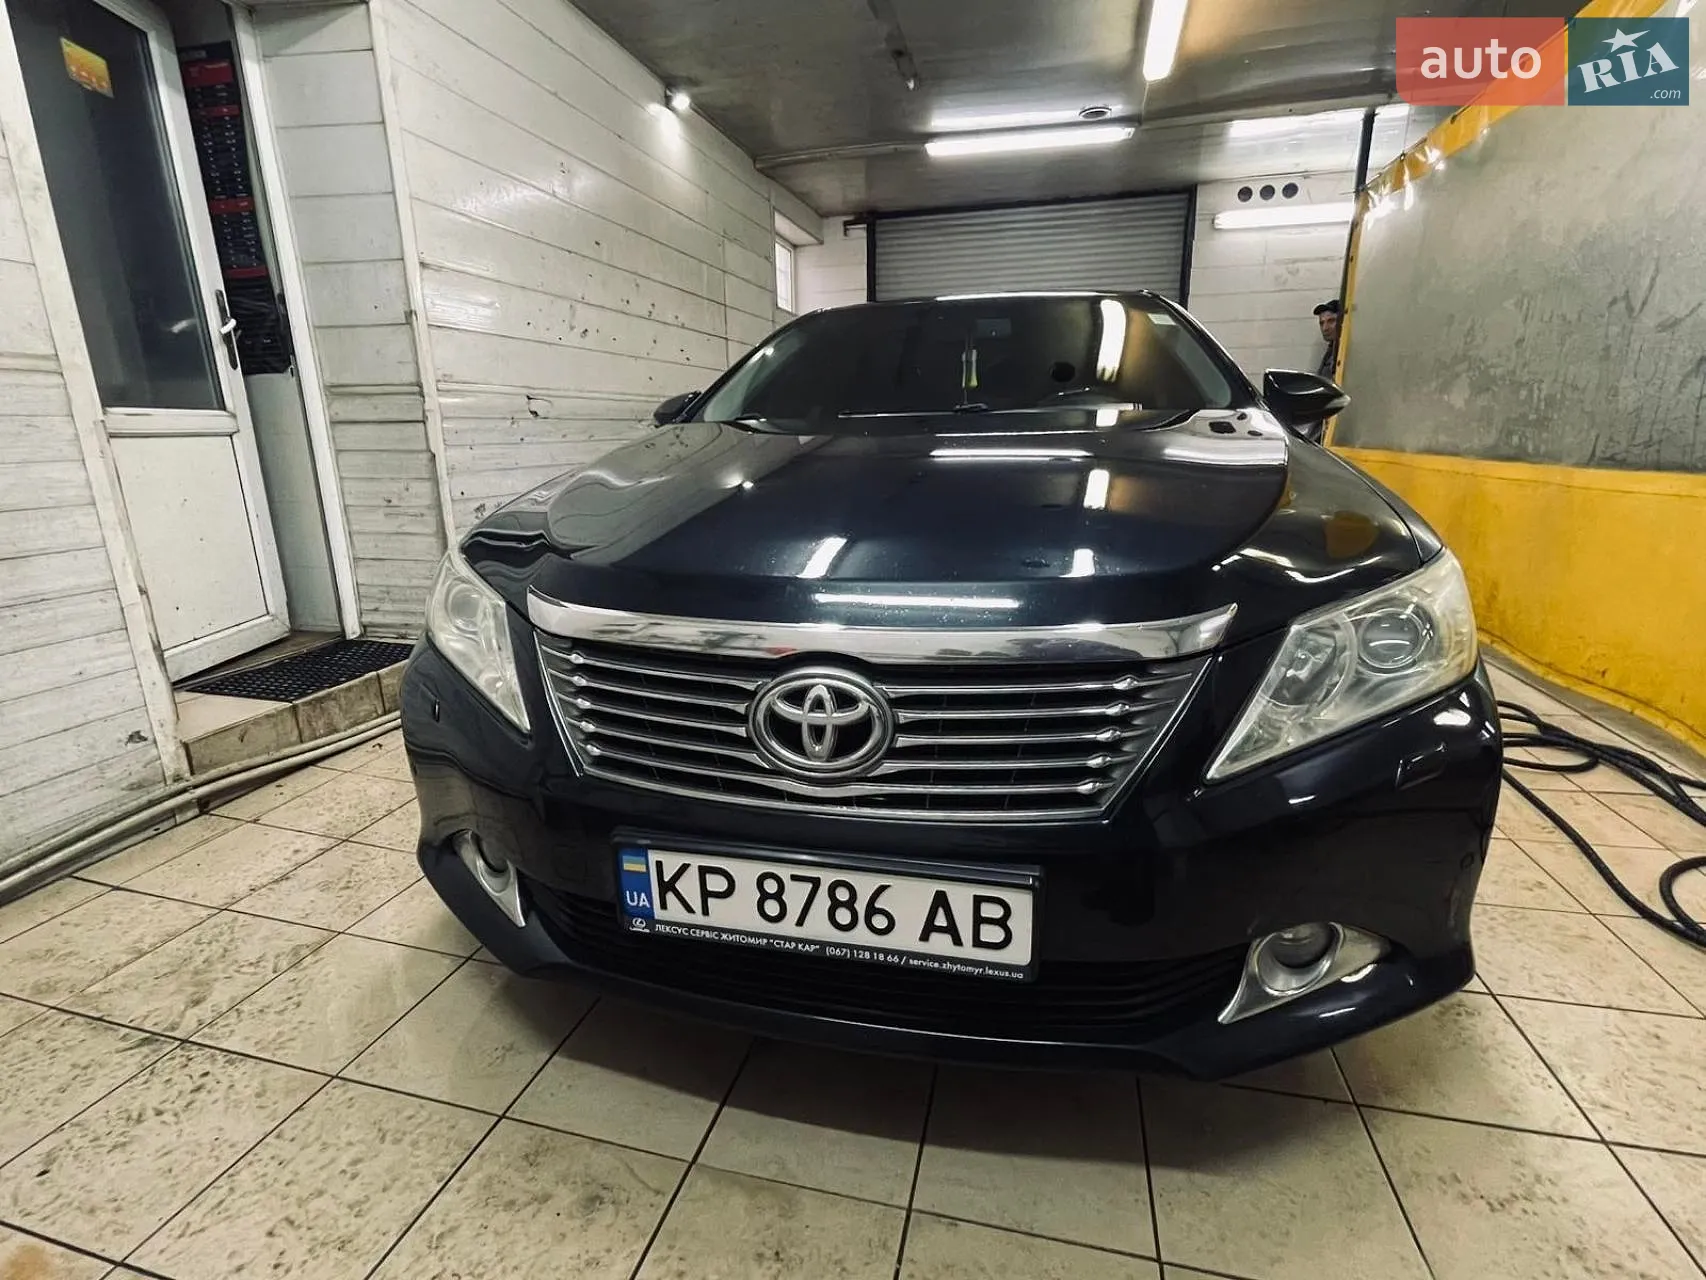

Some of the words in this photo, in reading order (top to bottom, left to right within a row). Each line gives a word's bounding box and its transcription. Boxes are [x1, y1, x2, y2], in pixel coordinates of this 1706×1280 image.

[626, 890, 650, 909] UA
[654, 859, 737, 917] KP
[755, 870, 896, 936] 8786
[918, 889, 1012, 950] AB
[655, 923, 688, 936] ЛЕКСУС
[690, 926, 719, 940] СЕРВІС
[720, 932, 767, 946] ЖИТОМИР
[825, 946, 850, 958] (067)
[853, 949, 870, 960] 128
[873, 952, 885, 961] 18
[886, 954, 899, 963] 66
[909, 957, 1024, 979] service.zhytomyr.lexus.ua
